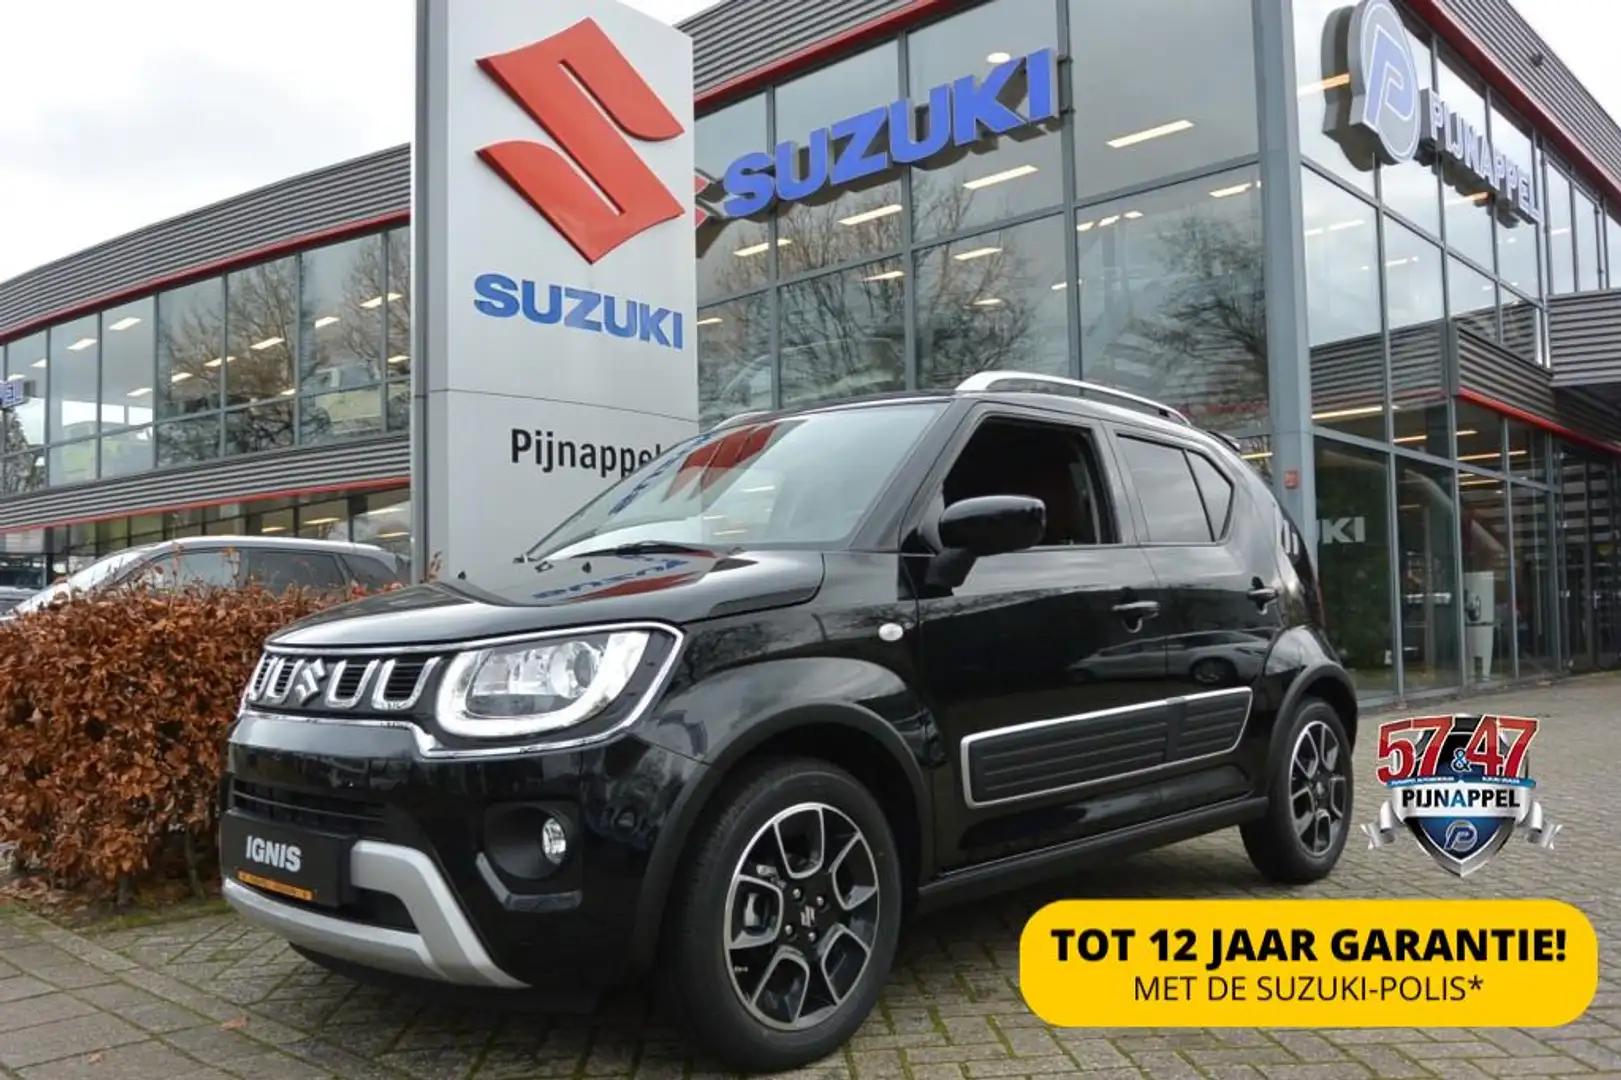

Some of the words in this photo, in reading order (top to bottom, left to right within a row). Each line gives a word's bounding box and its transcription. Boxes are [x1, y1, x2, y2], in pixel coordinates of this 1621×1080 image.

[723, 47, 1057, 218] SUZUKI
[1429, 87, 1541, 222] PIJNAPPEL
[474, 272, 683, 350] SUZUKI
[246, 836, 301, 872] IGNIS
